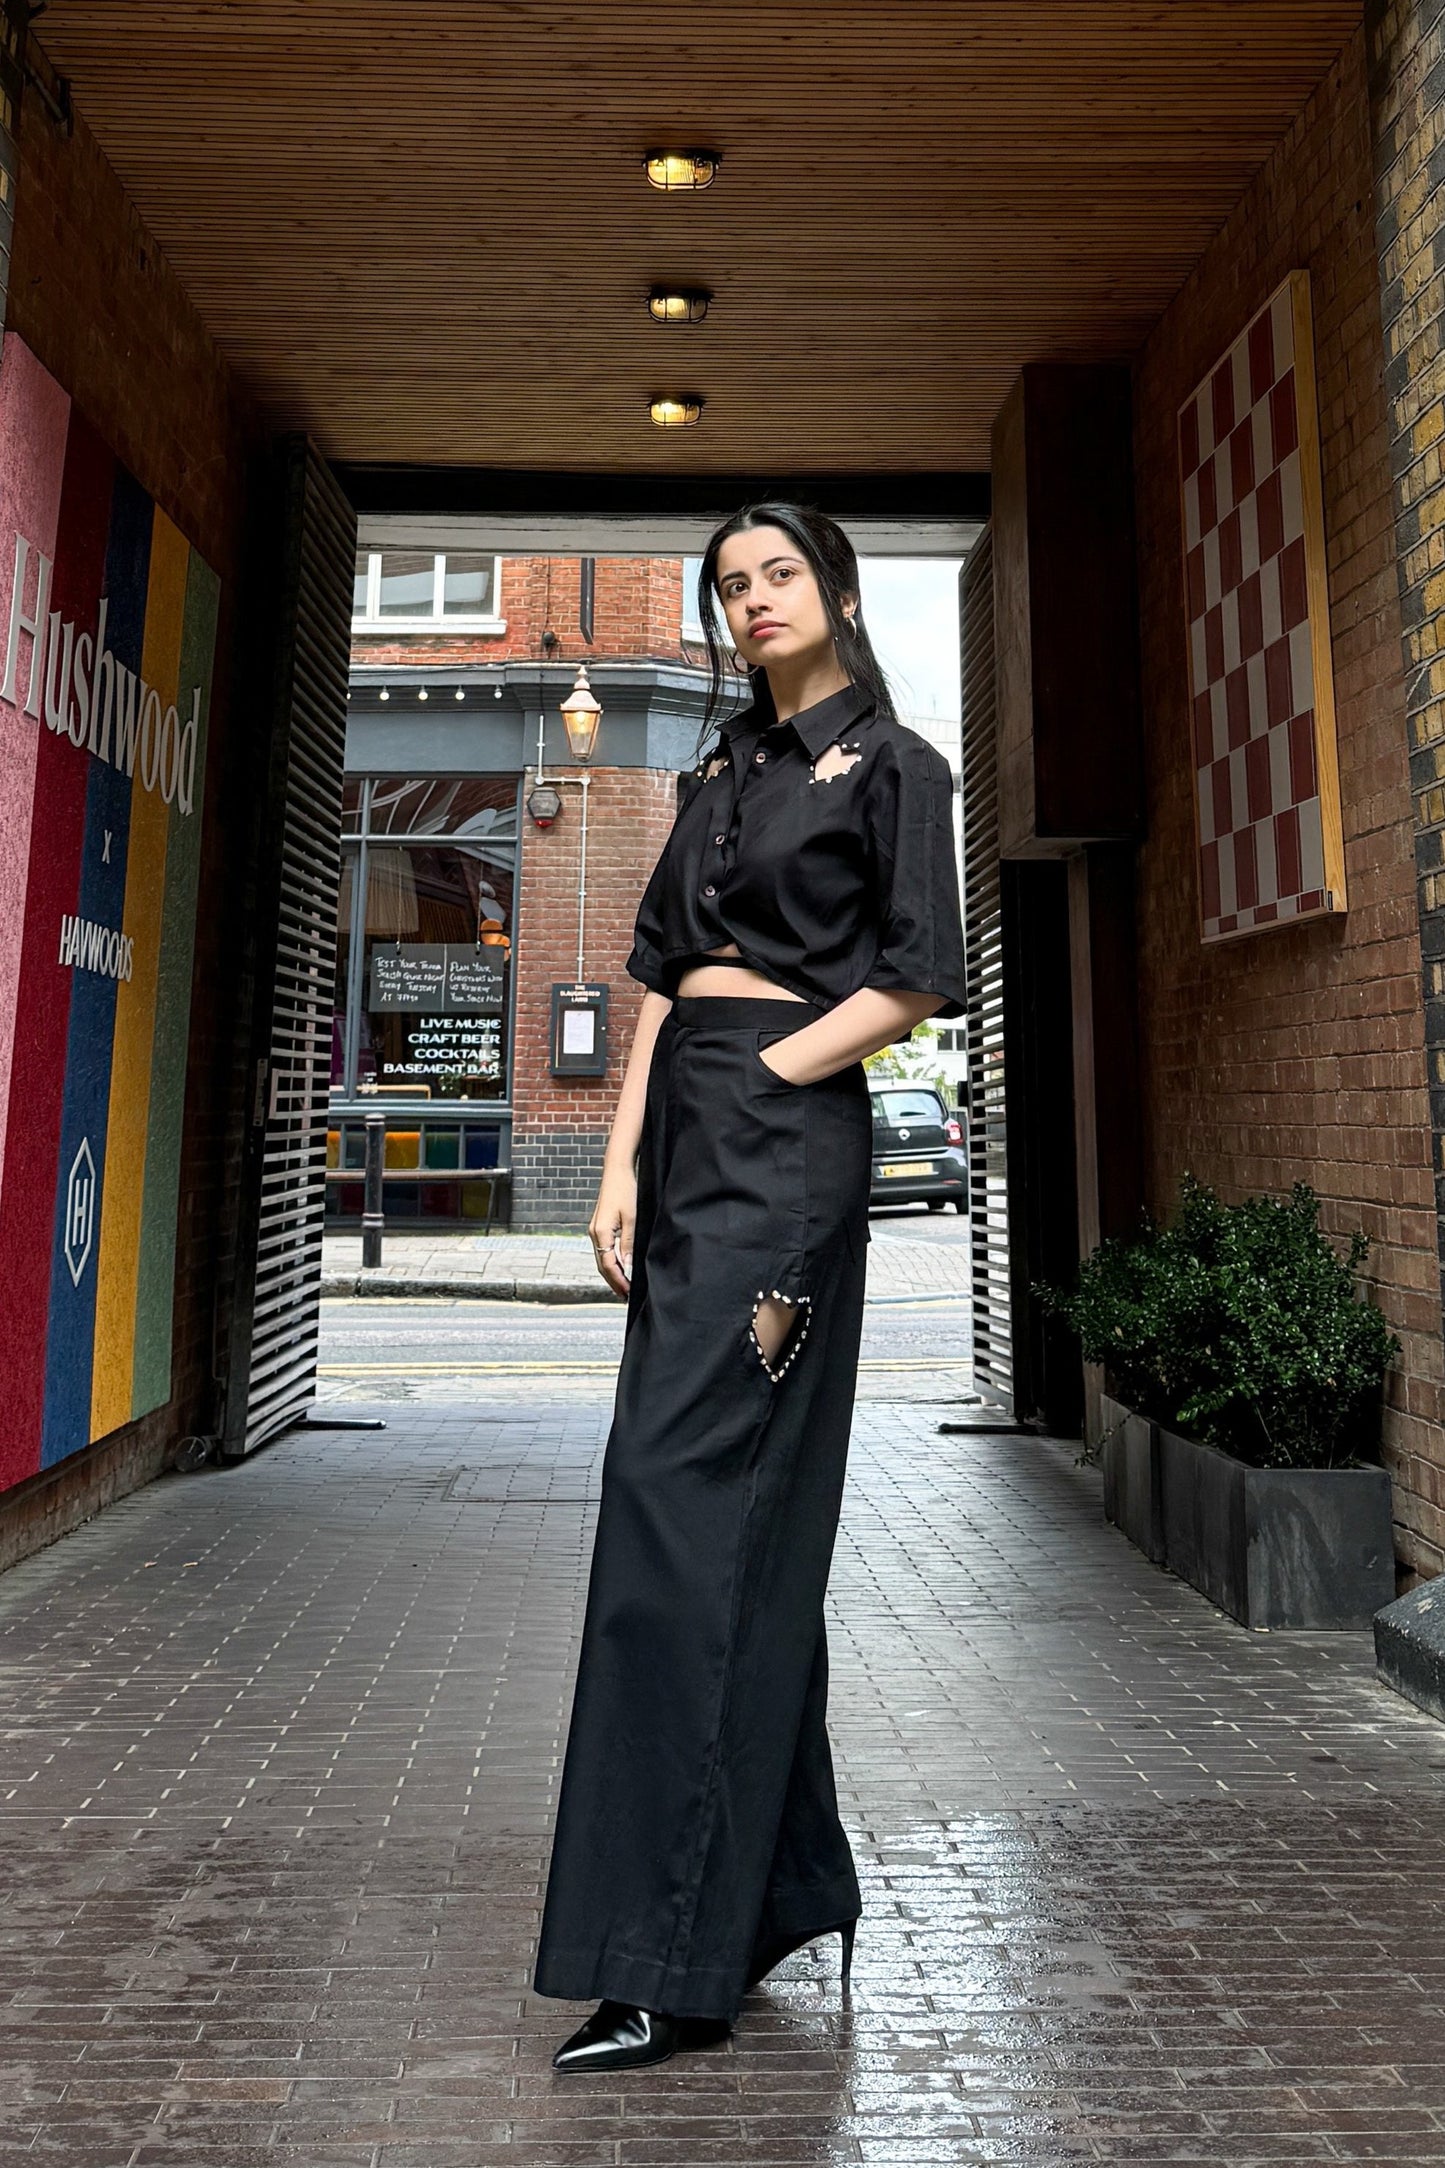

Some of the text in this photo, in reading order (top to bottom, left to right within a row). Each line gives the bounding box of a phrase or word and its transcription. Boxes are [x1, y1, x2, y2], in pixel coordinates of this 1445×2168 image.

[0, 530, 201, 817] Hushwood
[58, 914, 134, 983] HAVWOODS
[421, 1019, 502, 1029] LIVE MUSIC
[407, 1033, 501, 1044] CRAFT BEER
[414, 1048, 501, 1059] COCKTAILS
[383, 1063, 499, 1074] BASEMENT BAR
